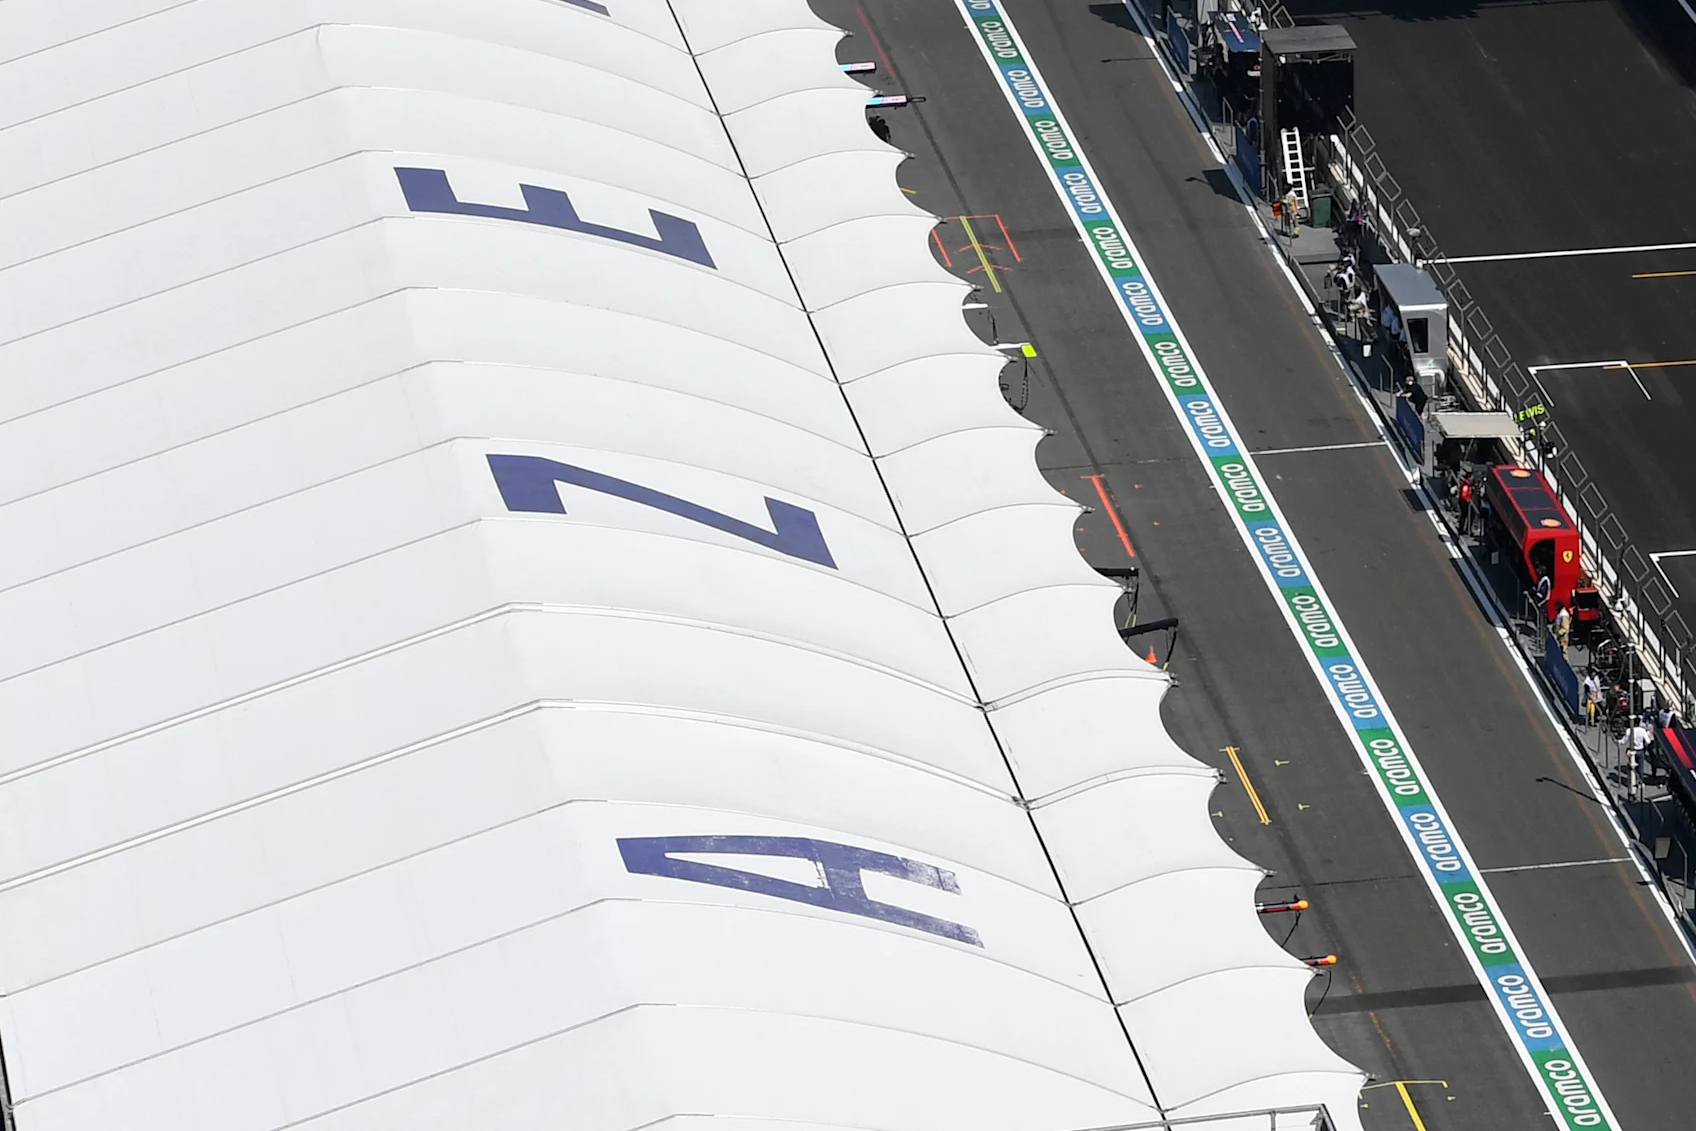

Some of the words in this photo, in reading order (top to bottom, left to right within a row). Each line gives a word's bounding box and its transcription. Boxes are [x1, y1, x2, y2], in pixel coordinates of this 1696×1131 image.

[981, 22, 1018, 58] aramco
[1007, 70, 1044, 108] aramco
[1035, 120, 1073, 160] aramco
[1064, 173, 1102, 213] aramco
[1093, 227, 1133, 268] aramco
[1122, 282, 1163, 325] aramco
[1155, 342, 1197, 386] aramco
[1187, 402, 1231, 447] aramco
[1221, 464, 1265, 512] aramco
[1255, 528, 1301, 577] aramco
[1292, 596, 1339, 647] aramco
[1329, 664, 1378, 718] aramco
[1370, 740, 1420, 795] aramco
[1410, 813, 1461, 870] aramco
[1453, 894, 1507, 953] aramco
[1498, 975, 1553, 1038] aramco
[1545, 1060, 1602, 1127] aramco
